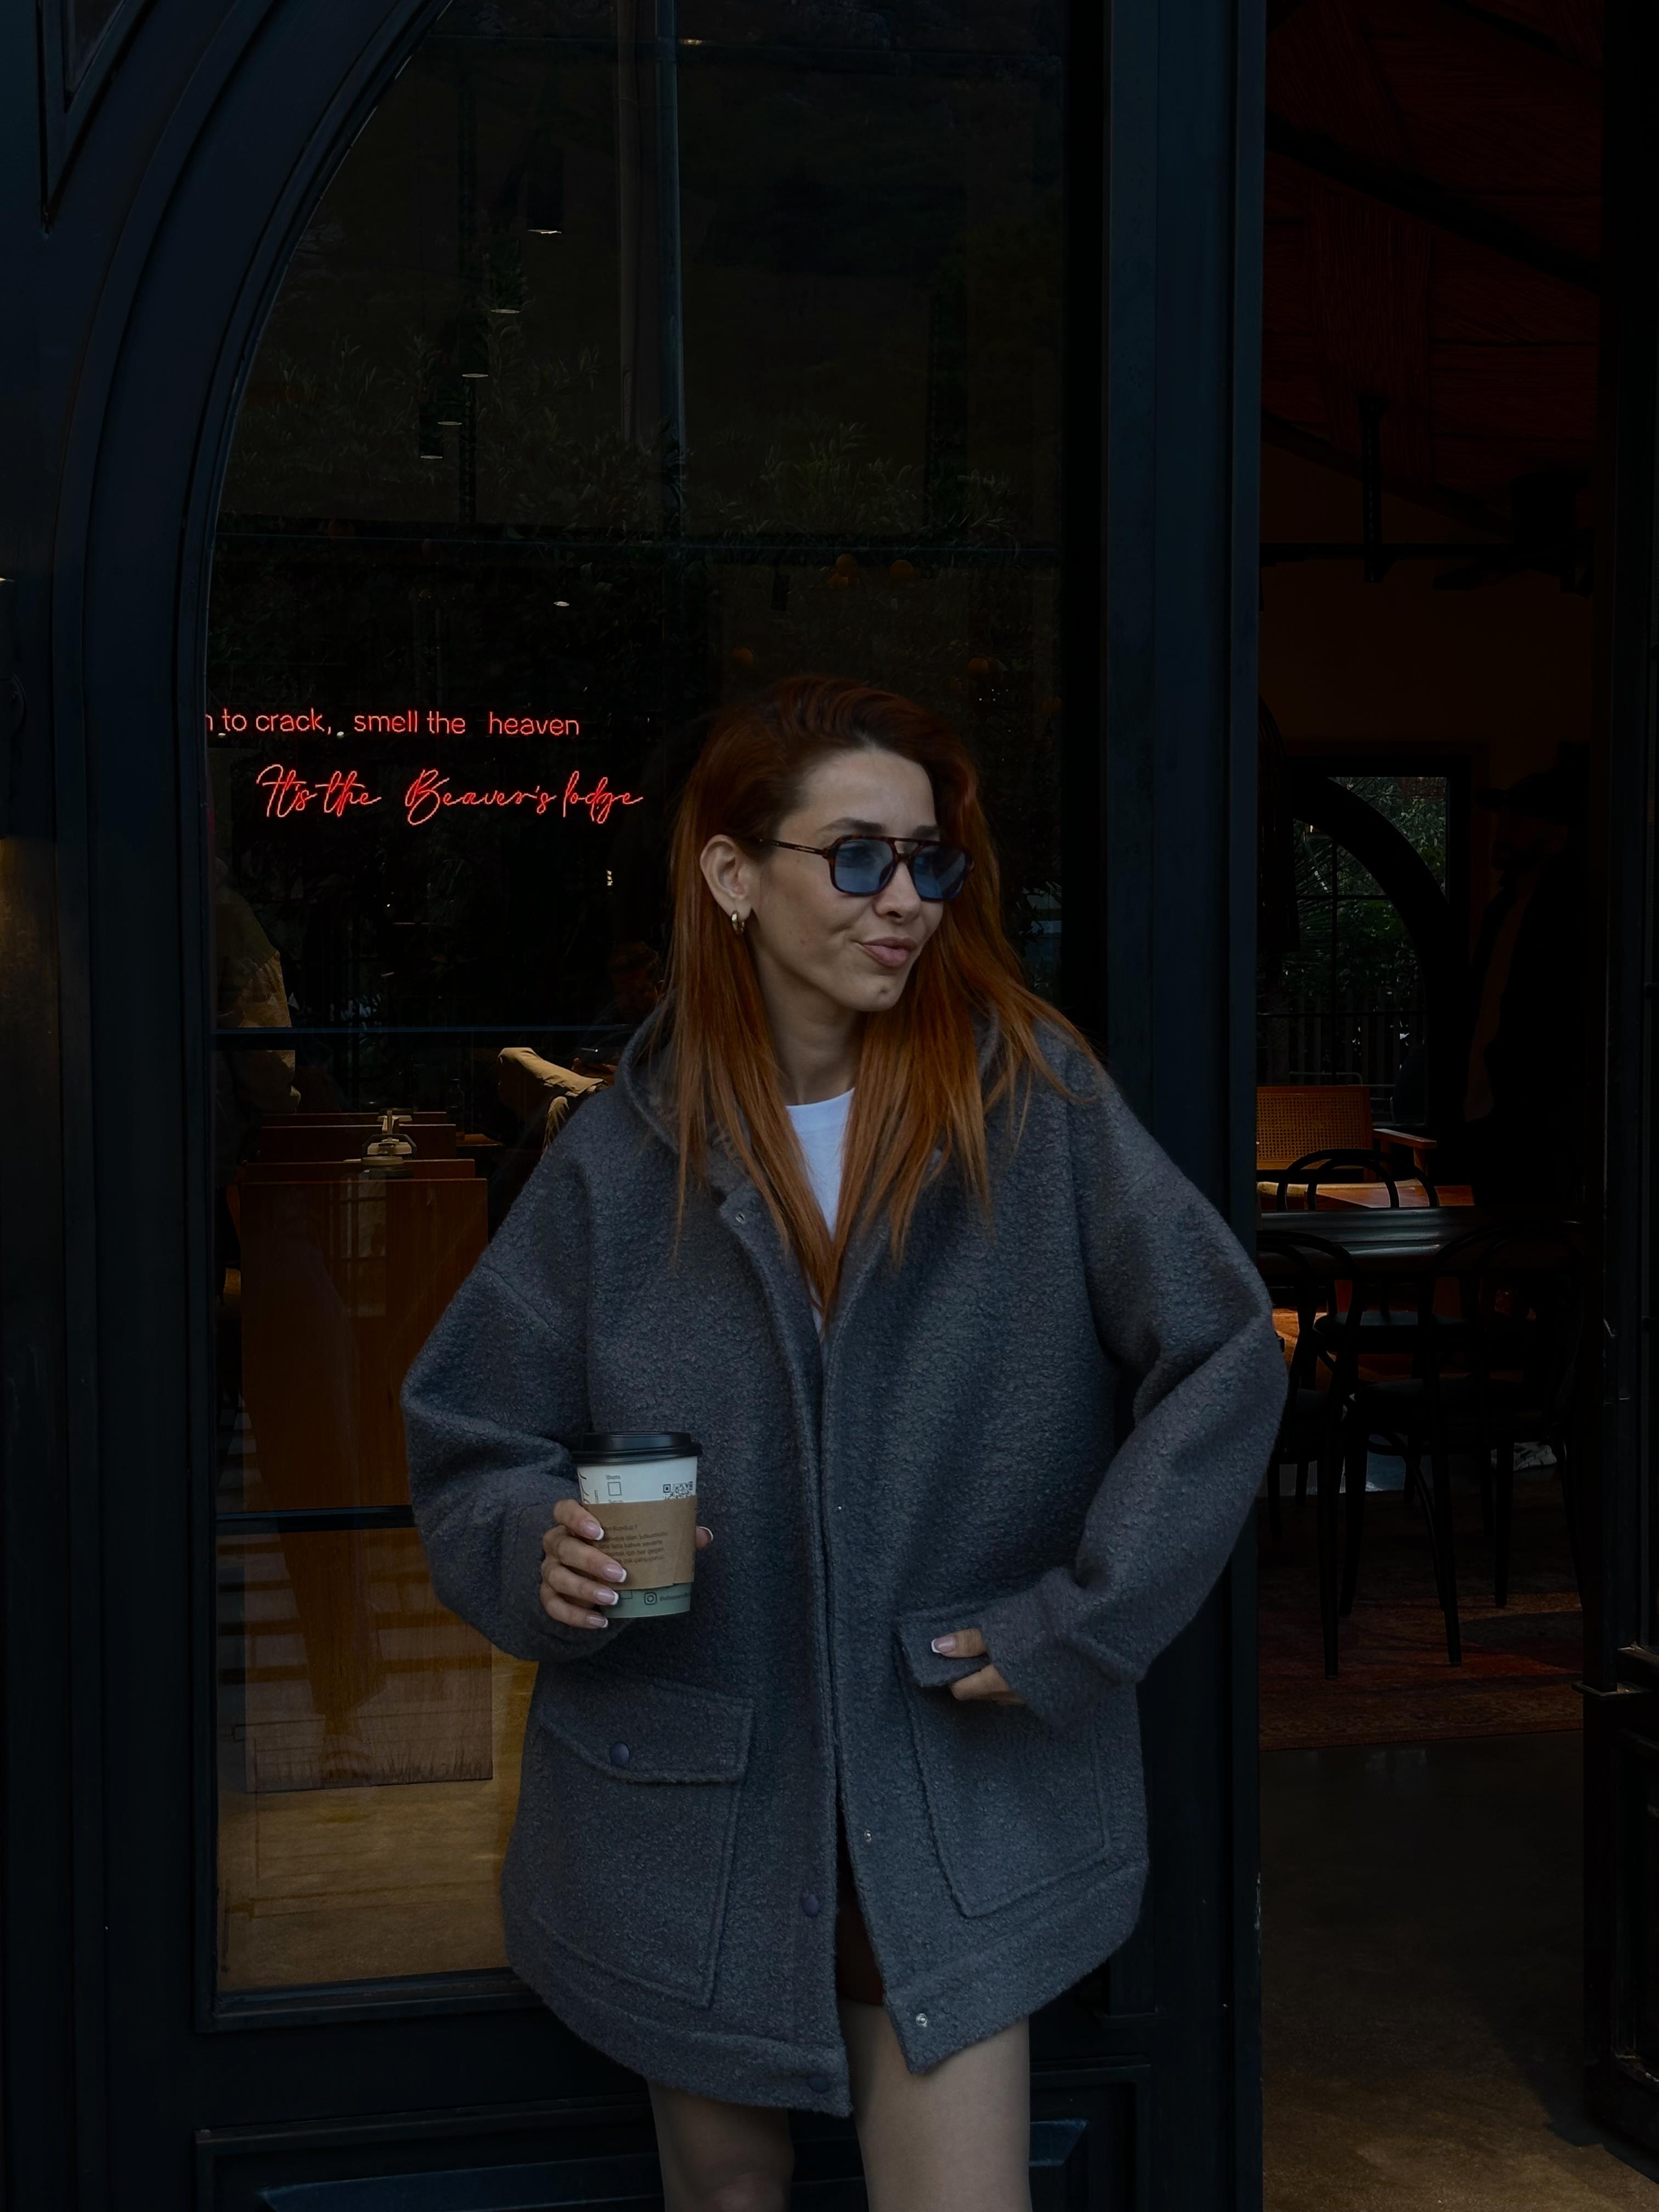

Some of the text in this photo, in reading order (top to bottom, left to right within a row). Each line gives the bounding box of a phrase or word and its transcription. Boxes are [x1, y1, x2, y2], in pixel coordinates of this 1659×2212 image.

[221, 708, 248, 732] to
[255, 707, 332, 735] crack,
[353, 710, 419, 733] smell
[426, 710, 466, 734] the
[488, 712, 580, 737] heaven
[255, 763, 644, 826] It's the Beaver's lodge
